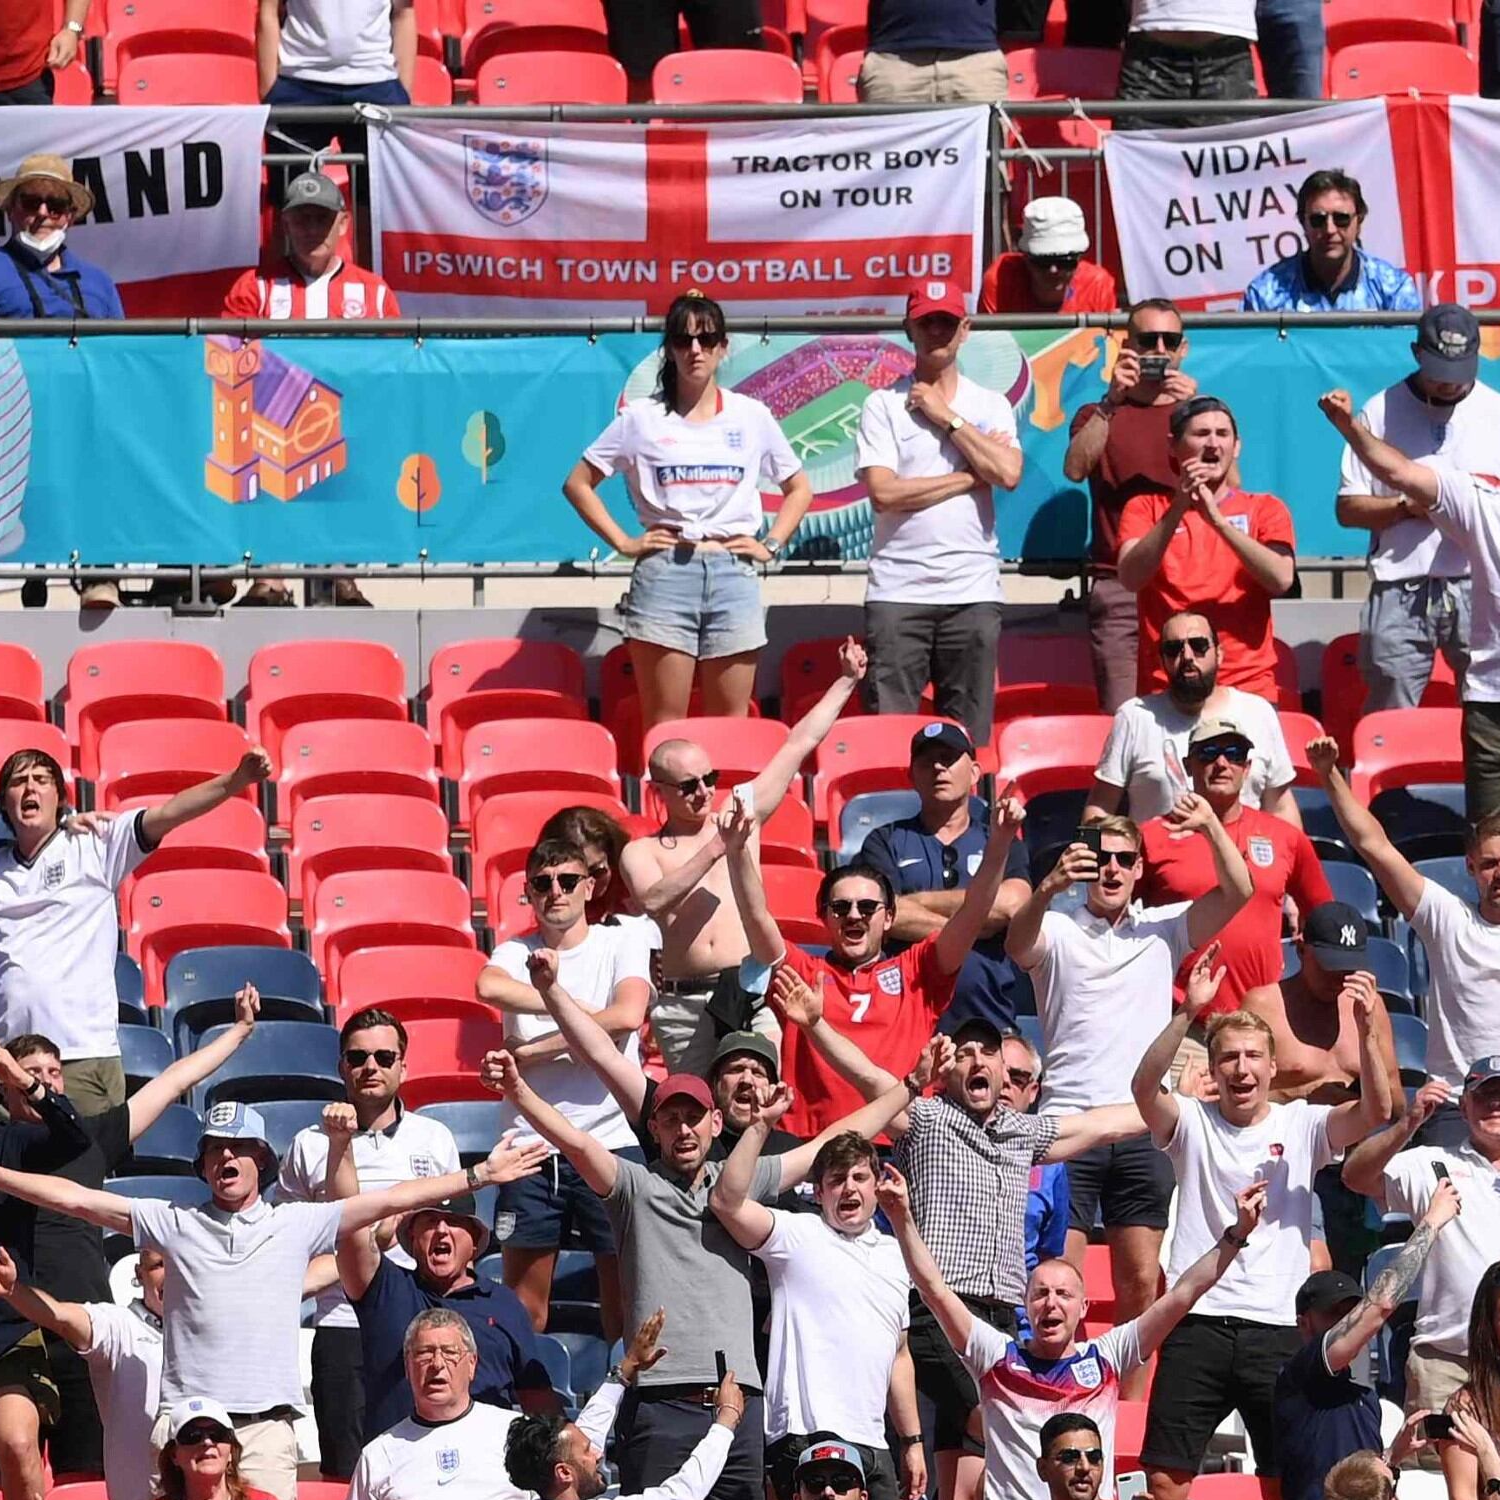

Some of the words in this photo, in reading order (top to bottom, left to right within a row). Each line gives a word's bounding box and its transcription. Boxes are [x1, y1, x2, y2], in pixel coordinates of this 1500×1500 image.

[732, 151, 873, 176] TRACTOR
[885, 147, 960, 172] BOYS
[1181, 137, 1307, 179] VIDAL
[780, 190, 823, 210] ON
[833, 186, 914, 209] TOUR
[1164, 183, 1301, 230] ALWAY
[403, 250, 544, 282] IPSWICH
[557, 257, 656, 285] TOWN
[669, 260, 853, 285] FOOTBALL
[864, 253, 954, 280] CLUB
[1164, 241, 1224, 277] ON
[1246, 230, 1309, 265] TO
[675, 465, 743, 483] Nationwide
[849, 993, 871, 1024] 7
